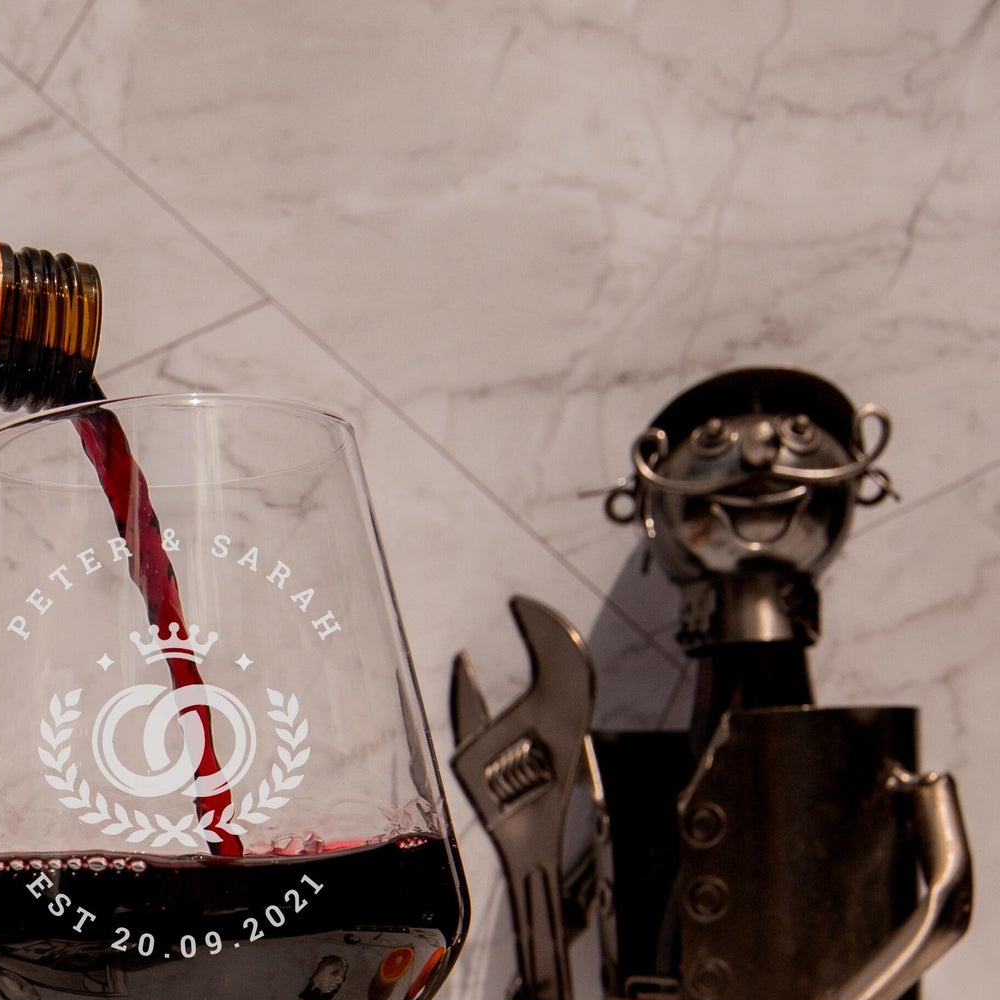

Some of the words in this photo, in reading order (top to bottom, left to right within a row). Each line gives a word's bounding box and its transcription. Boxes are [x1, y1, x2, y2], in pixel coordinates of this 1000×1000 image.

[7, 536, 133, 641] PETER
[160, 528, 182, 553] &
[210, 534, 342, 641] SARAH
[25, 871, 97, 934] EST
[110, 873, 325, 959] 20.09.2021
